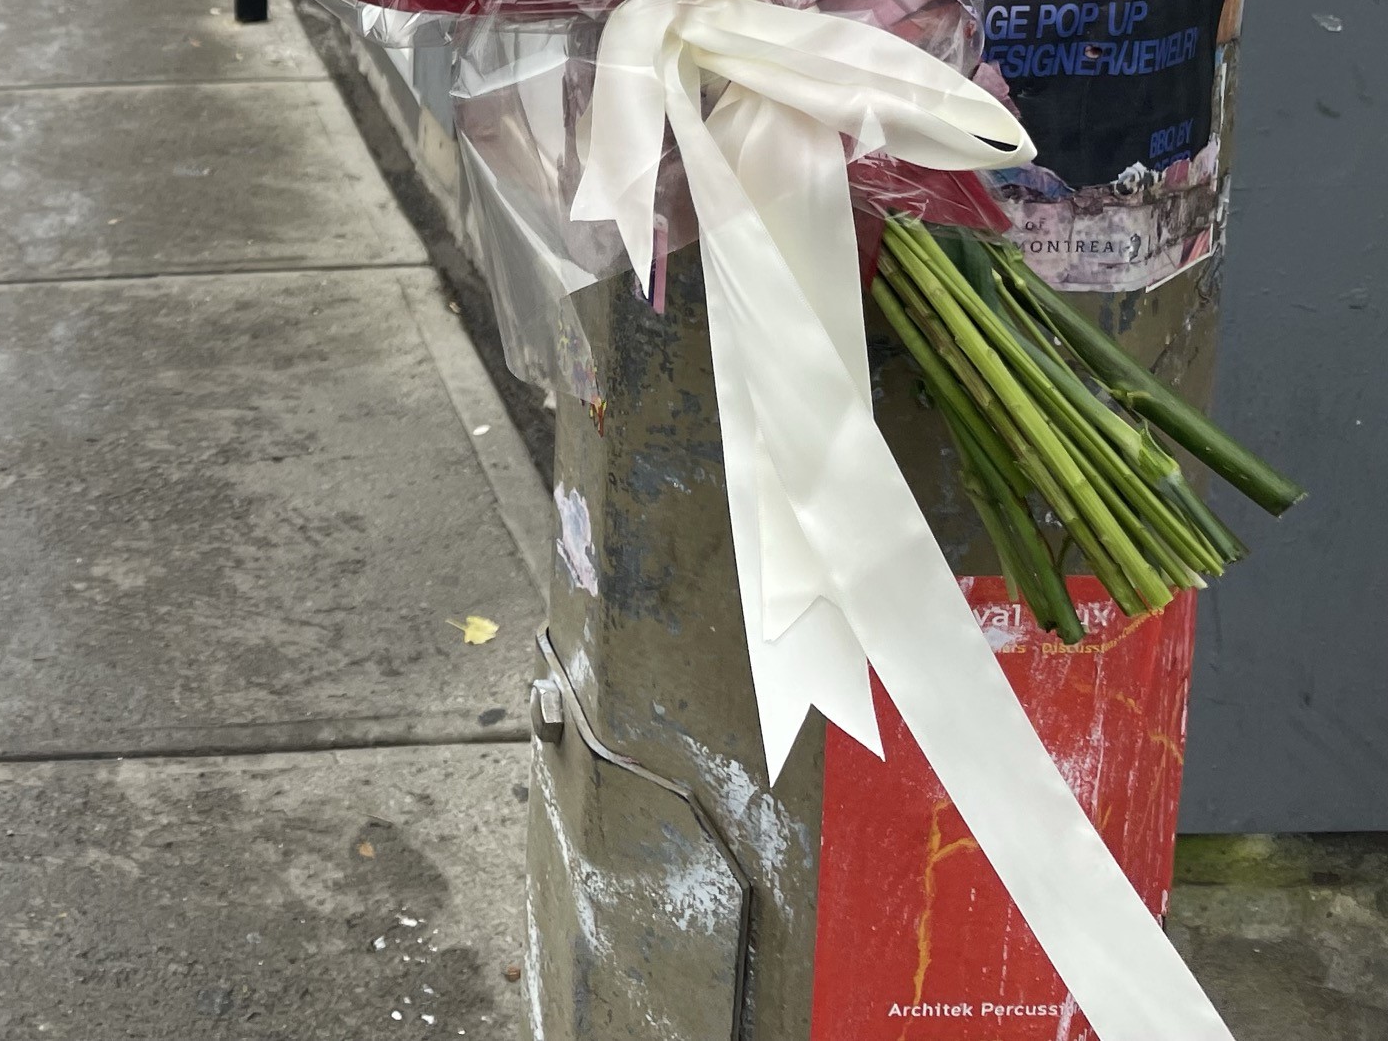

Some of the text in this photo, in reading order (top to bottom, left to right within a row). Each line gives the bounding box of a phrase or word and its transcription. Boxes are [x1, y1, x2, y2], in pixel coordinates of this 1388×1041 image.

[1036, 2, 1099, 38] POP
[1107, 0, 1148, 37] UP
[983, 26, 1199, 79] ESIGNER/JEWELRY
[972, 604, 1021, 628] val
[888, 1002, 1069, 1017] Architek Percussi
